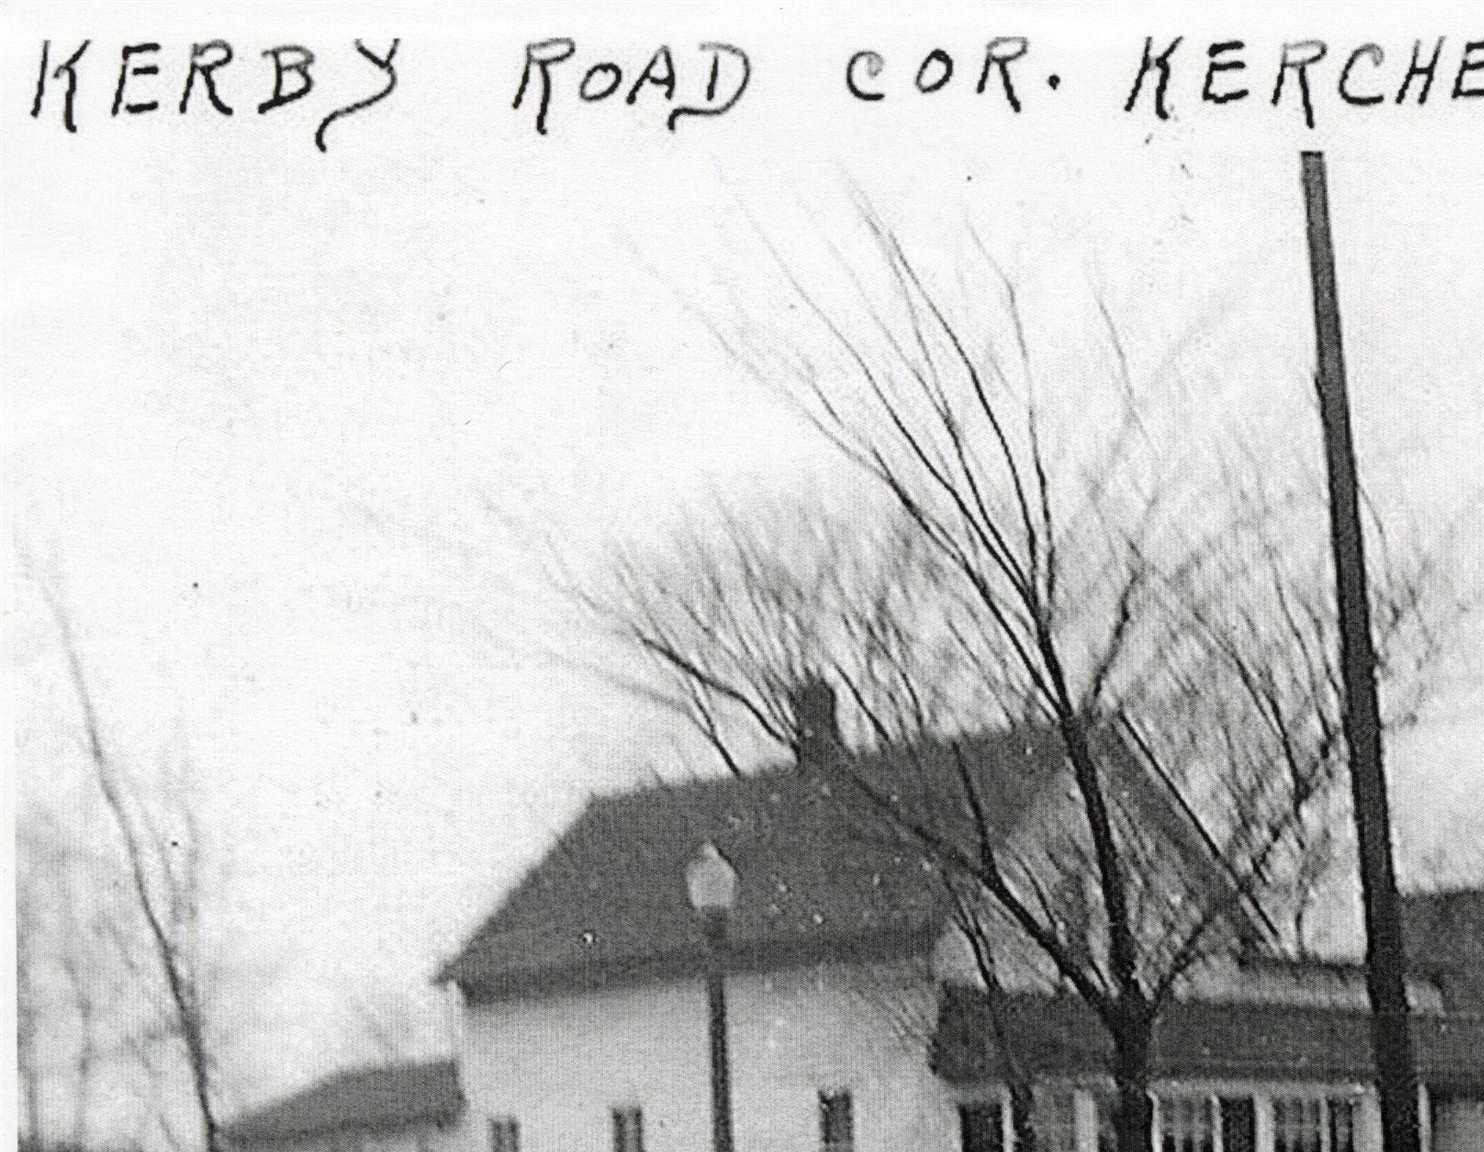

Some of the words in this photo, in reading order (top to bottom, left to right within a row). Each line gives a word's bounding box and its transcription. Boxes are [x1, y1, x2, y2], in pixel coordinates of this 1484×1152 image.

[30, 38, 400, 151] KERBY
[511, 37, 751, 134] ROAD
[846, 39, 1061, 114] COR.
